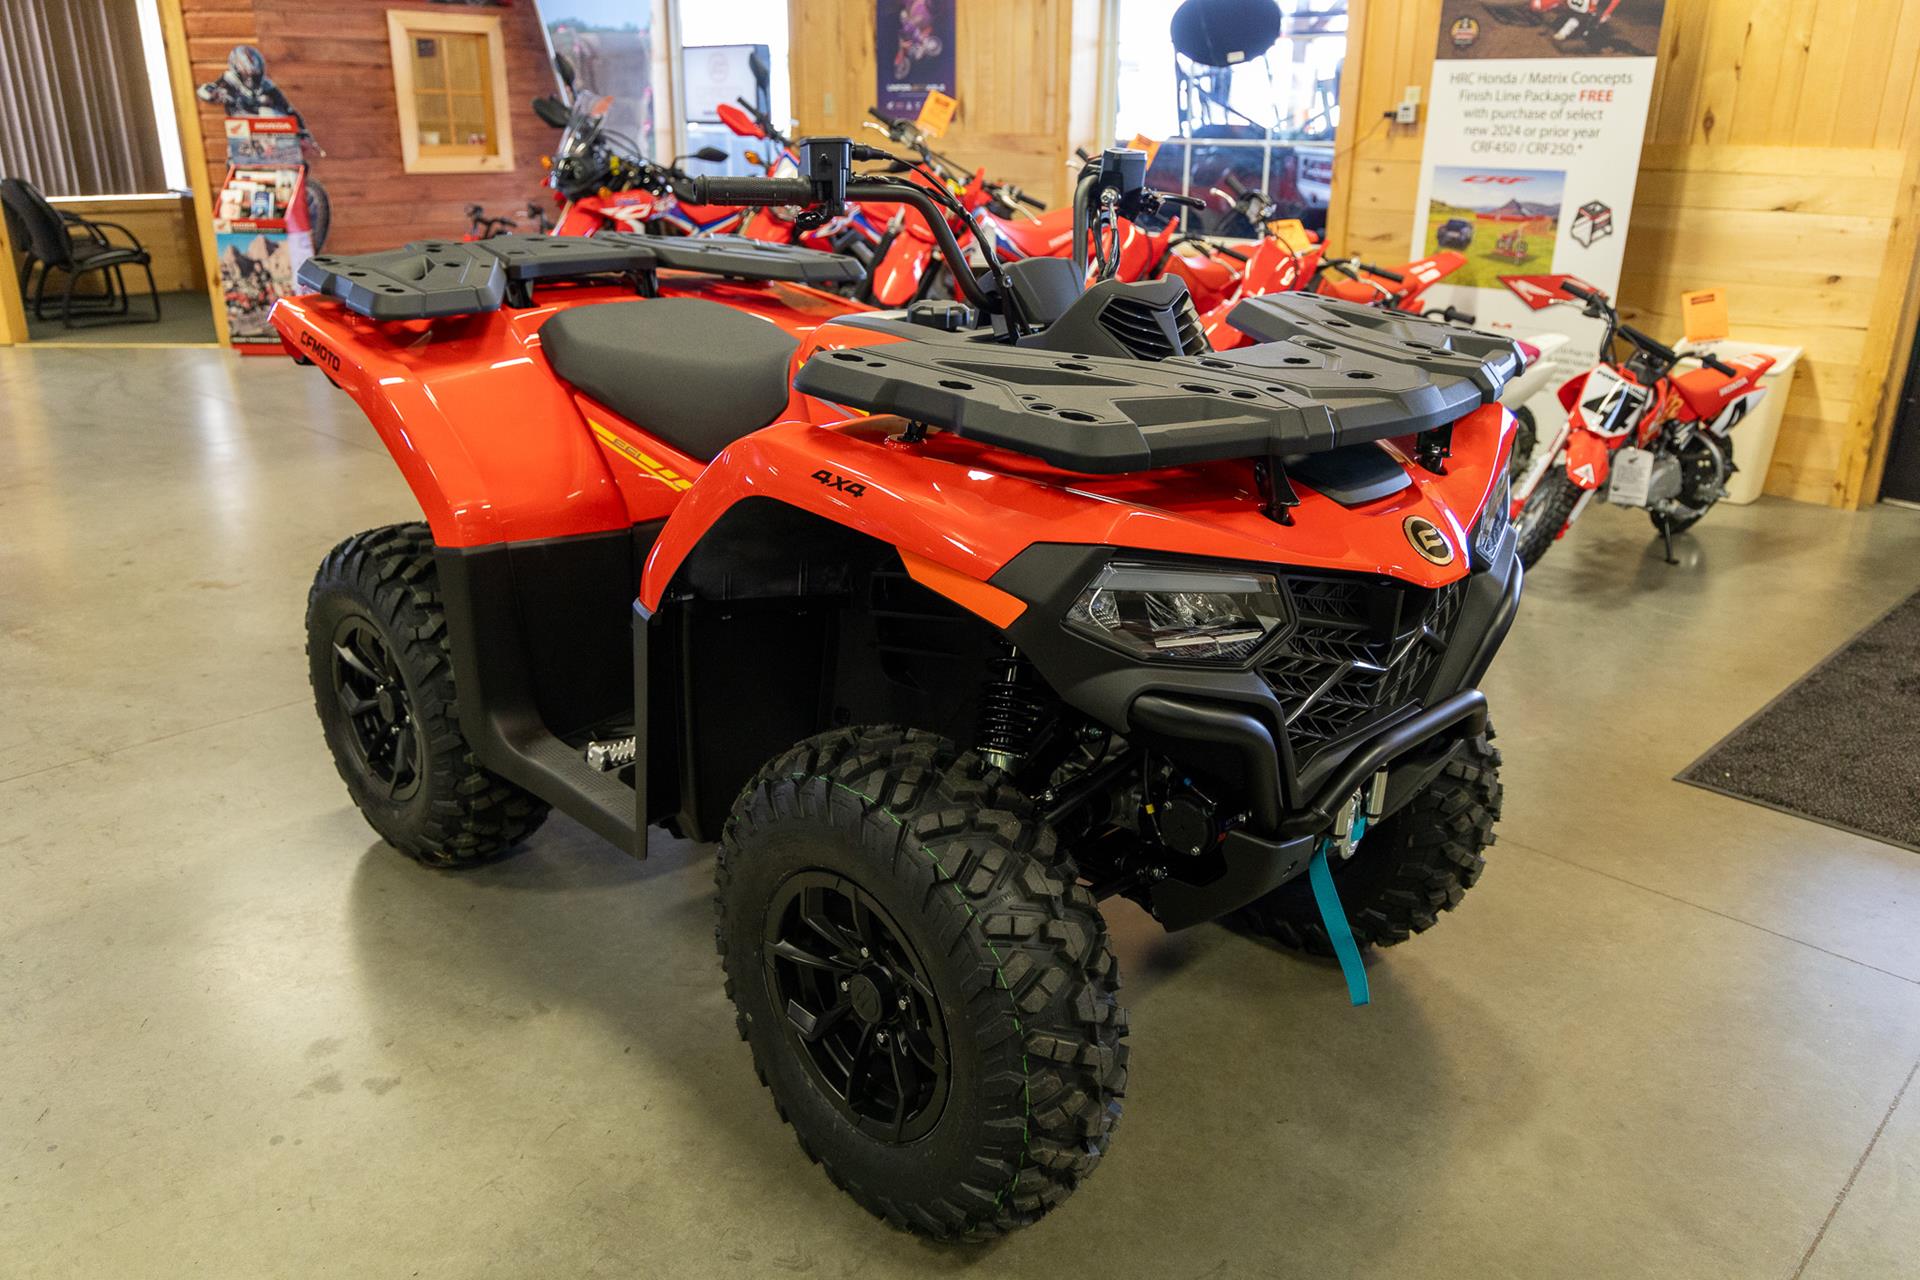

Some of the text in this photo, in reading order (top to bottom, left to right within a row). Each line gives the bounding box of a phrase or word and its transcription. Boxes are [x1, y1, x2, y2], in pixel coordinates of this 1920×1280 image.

[1450, 72, 1474, 85] HRC
[1477, 72, 1517, 85] Honda
[1528, 72, 1568, 85] Matrix
[1571, 71, 1633, 87] Concepts
[1459, 89, 1614, 104] Finish Line Package FREE
[1463, 107, 1603, 121] with purchase of select
[1463, 124, 1601, 140] new 2024 or prior year
[1471, 141, 1517, 154] CRF450
[300, 330, 341, 372] CFMOTO
